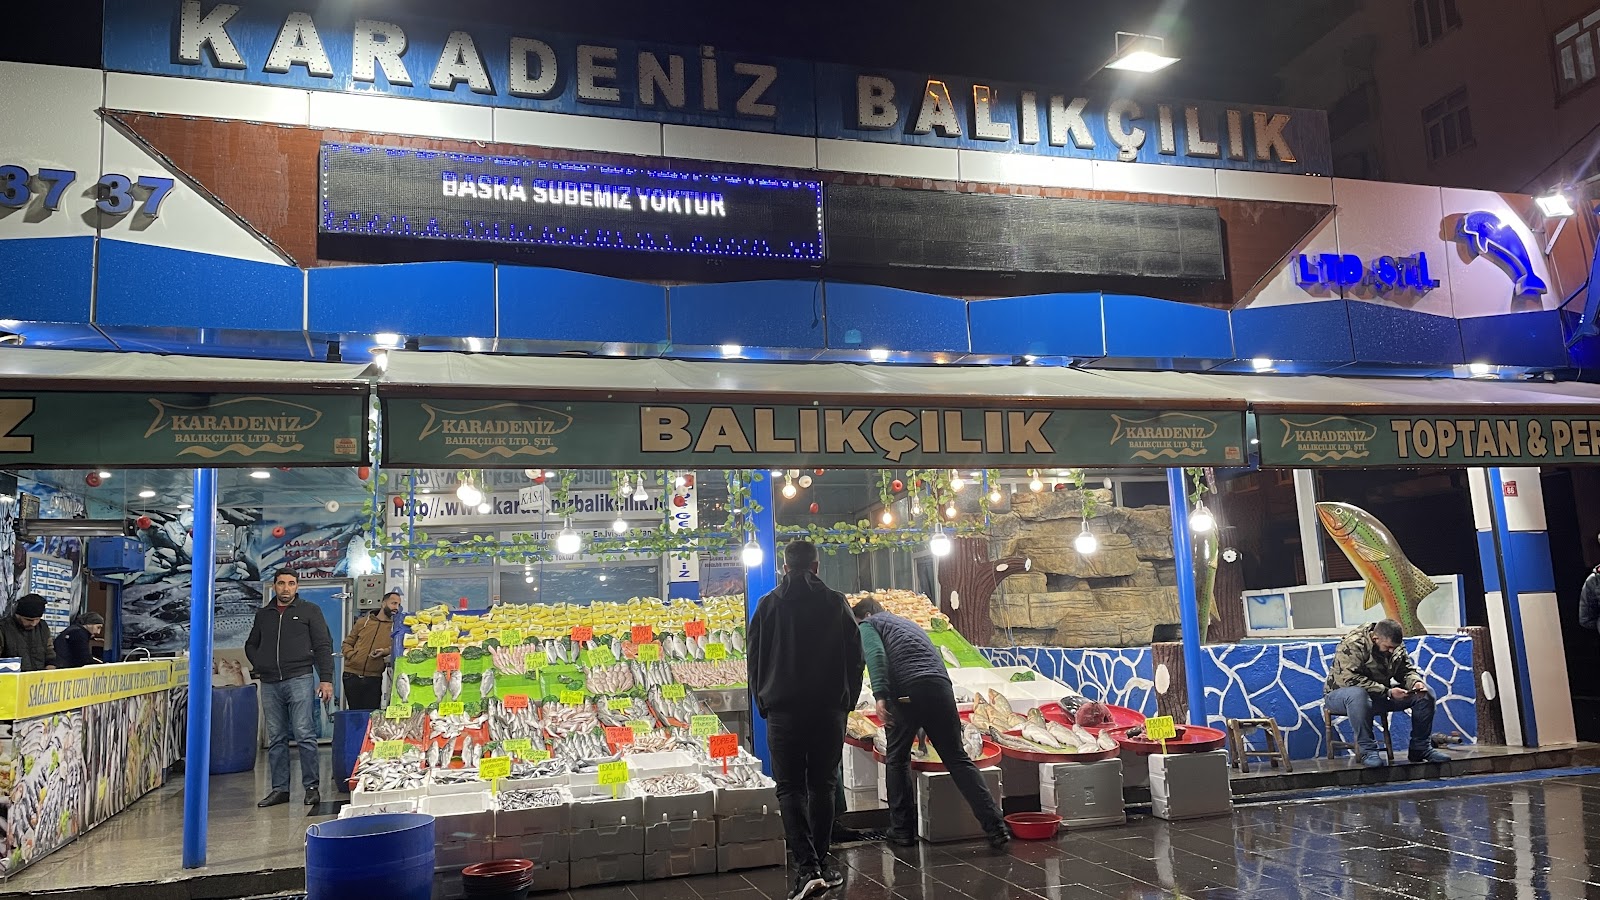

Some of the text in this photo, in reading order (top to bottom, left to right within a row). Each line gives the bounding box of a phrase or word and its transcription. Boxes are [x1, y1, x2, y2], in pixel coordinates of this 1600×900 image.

[177, 0, 1297, 163] KARADENİZ BALIKÇILIK
[0, 164, 175, 219] 37 37
[636, 185, 727, 217] YOKTUR
[171, 412, 301, 432] KARADENİZ
[442, 417, 556, 434] KARADENİZ
[175, 434, 244, 445] BALIKÇILIK
[248, 434, 273, 443] LTD.
[639, 405, 1056, 462] BALIKÇILIK
[1125, 424, 1206, 438] KARADENİZ
[1295, 427, 1368, 441] KARADENİZ
[1390, 418, 1521, 458] TOPTAN
[1526, 418, 1548, 458] &
[445, 436, 506, 447] BALIKÇILIK
[509, 437, 531, 446] LTD.
[1129, 441, 1171, 449] BALIKÇILIK
[1298, 443, 1337, 452] BALIKÇILIK
[521, 490, 543, 506] KASA
[28, 677, 62, 707] SAĞLIKLI
[73, 677, 91, 699] UZUN
